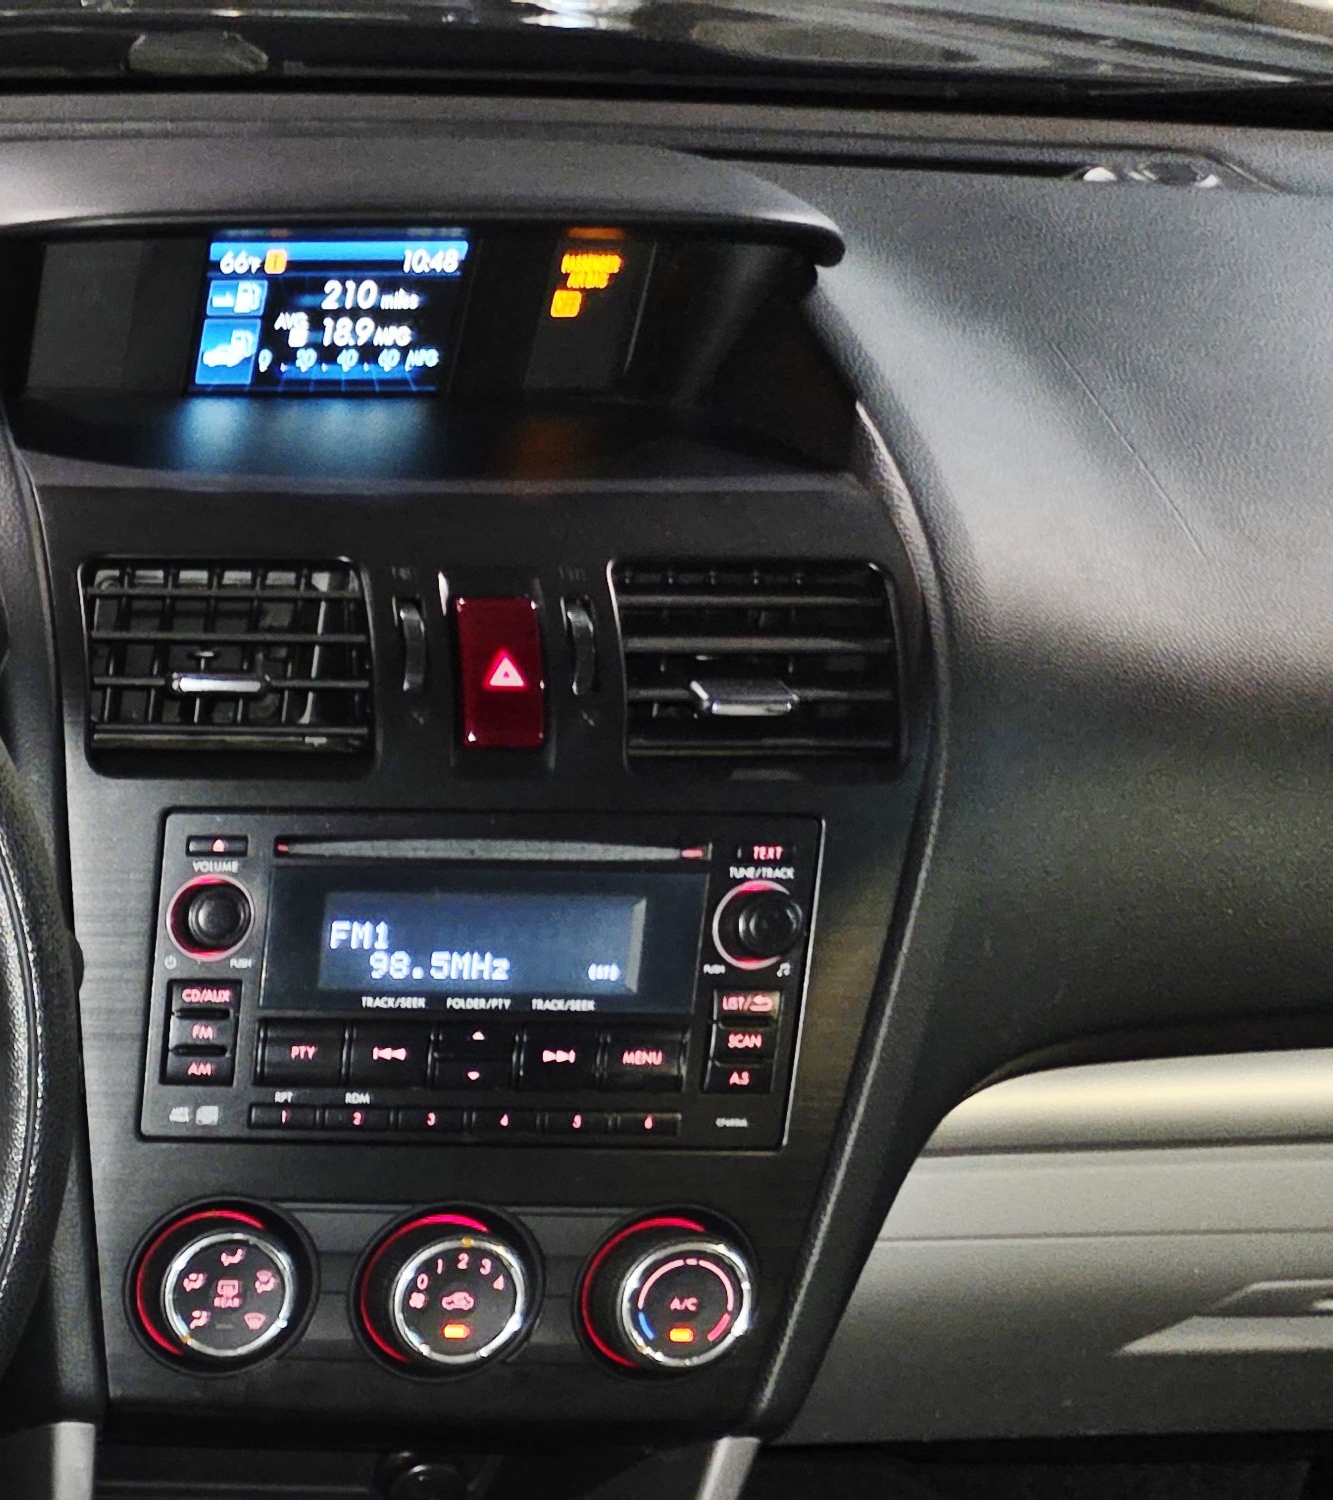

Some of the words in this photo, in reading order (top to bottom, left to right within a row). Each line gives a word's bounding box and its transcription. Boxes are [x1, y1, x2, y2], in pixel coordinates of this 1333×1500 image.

[321, 279, 380, 310] 210
[274, 312, 309, 331] AVG
[322, 317, 376, 347] 18.9
[753, 846, 783, 860] TEXT
[193, 861, 239, 873] VOLUME
[330, 921, 390, 950] FM1
[369, 951, 511, 980] 98.5MHz
[182, 989, 231, 1003] CD/AUX
[361, 996, 426, 1009] TRACK/SEEK
[192, 1025, 214, 1040] FM
[728, 1034, 762, 1048] SCAN
[291, 1046, 316, 1060] PTY
[623, 1051, 663, 1066] MENU
[187, 1062, 212, 1076] AM
[345, 1092, 370, 1104] RDM
[437, 1258, 443, 1274] 1
[457, 1253, 469, 1269] 2
[480, 1258, 491, 1275] 3
[417, 1273, 428, 1289] 0
[493, 1274, 504, 1290] 4
[670, 1297, 698, 1311] A/C
